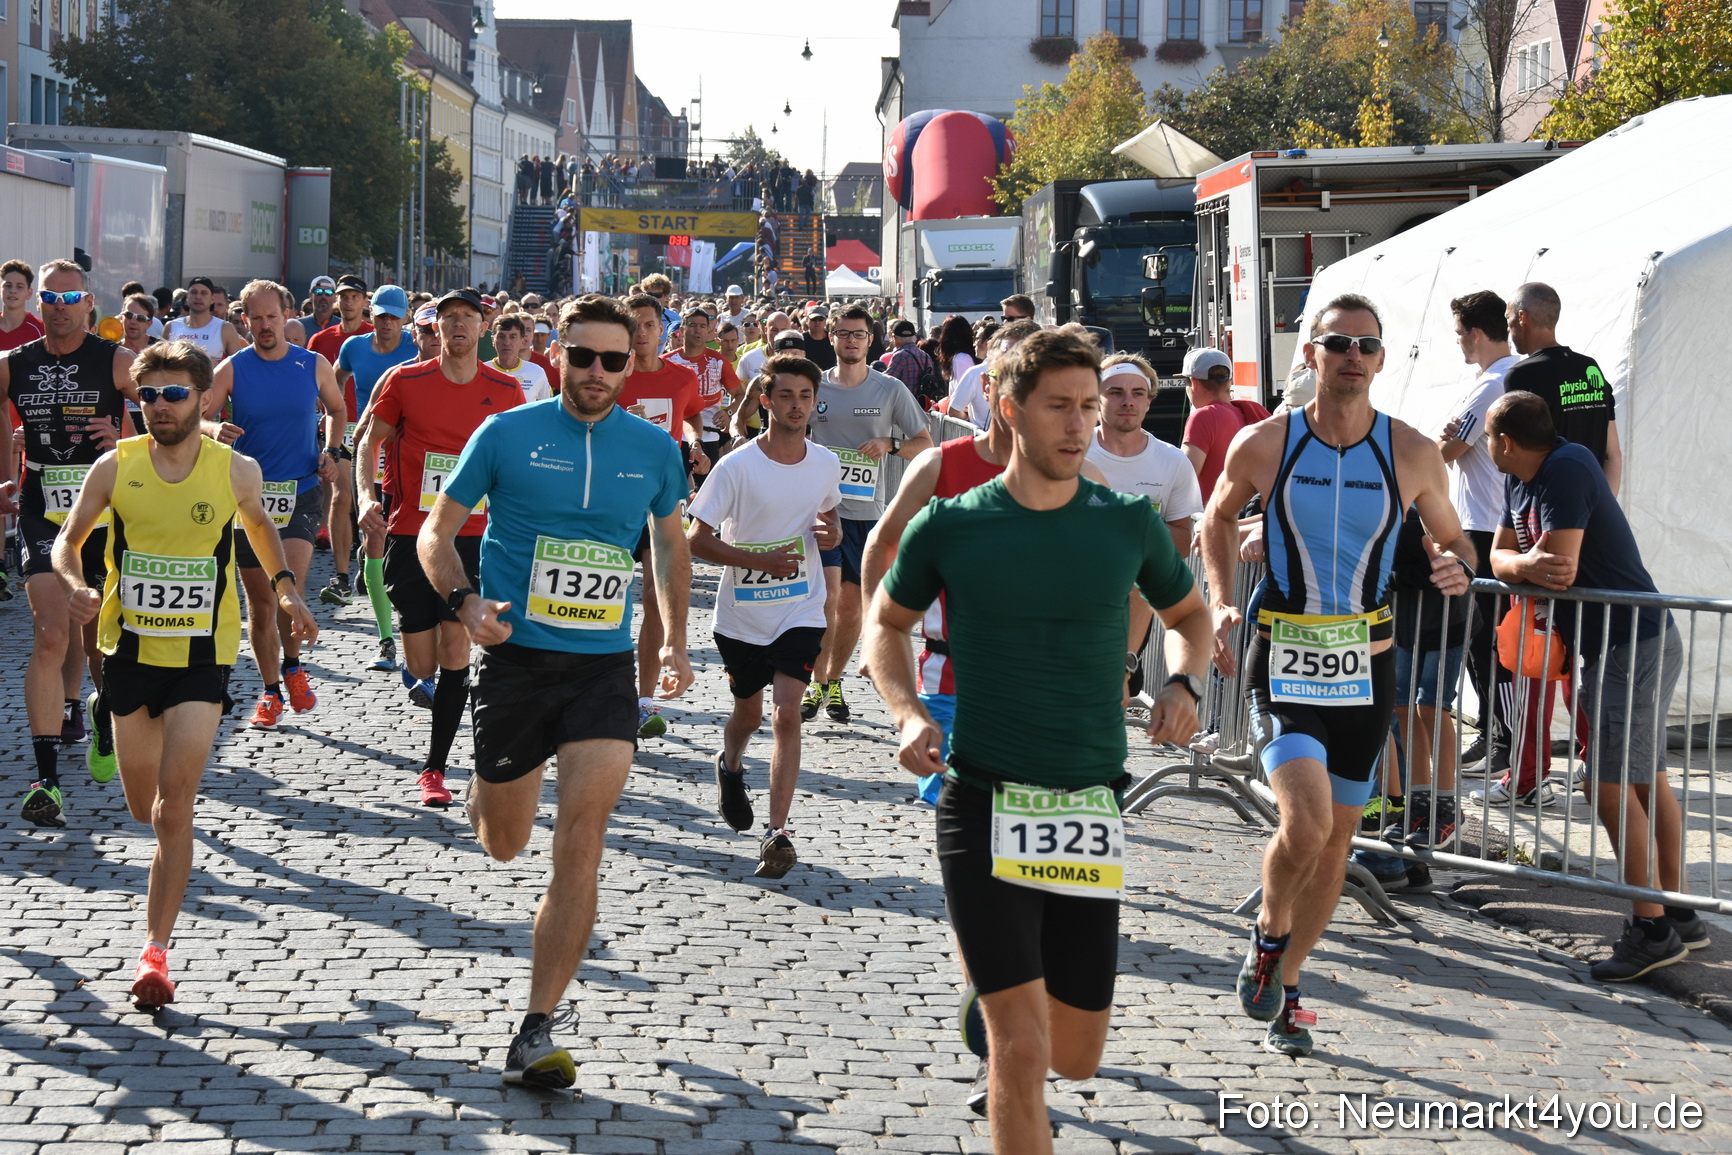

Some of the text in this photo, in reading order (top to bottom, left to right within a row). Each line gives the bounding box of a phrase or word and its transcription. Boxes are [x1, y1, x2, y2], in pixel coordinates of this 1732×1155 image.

[638, 215, 699, 230] START
[299, 227, 328, 245] BO
[948, 243, 995, 252] BOCK
[1148, 328, 1189, 337] MAN
[1559, 379, 1588, 397] physio
[18, 391, 100, 406] PIRATE
[1561, 389, 1604, 406] neumarkt
[25, 408, 52, 416] uvex
[529, 461, 574, 472] Hochschulsport
[841, 466, 872, 484] 750
[45, 469, 88, 484] BOC
[544, 542, 626, 567] BOCK
[130, 556, 207, 578] BOCK
[546, 568, 622, 600] 1320
[132, 582, 204, 609] 1325
[753, 587, 790, 599] KEVIN
[548, 604, 607, 620] LORENZ
[135, 615, 195, 627] THOMAS
[1280, 621, 1360, 645] BOCK
[1281, 649, 1359, 678] 2590
[1281, 682, 1360, 696] REINHARD
[1004, 788, 1112, 814] BOCK
[1010, 821, 1110, 857] 1323
[1017, 864, 1100, 883] THOMAS
